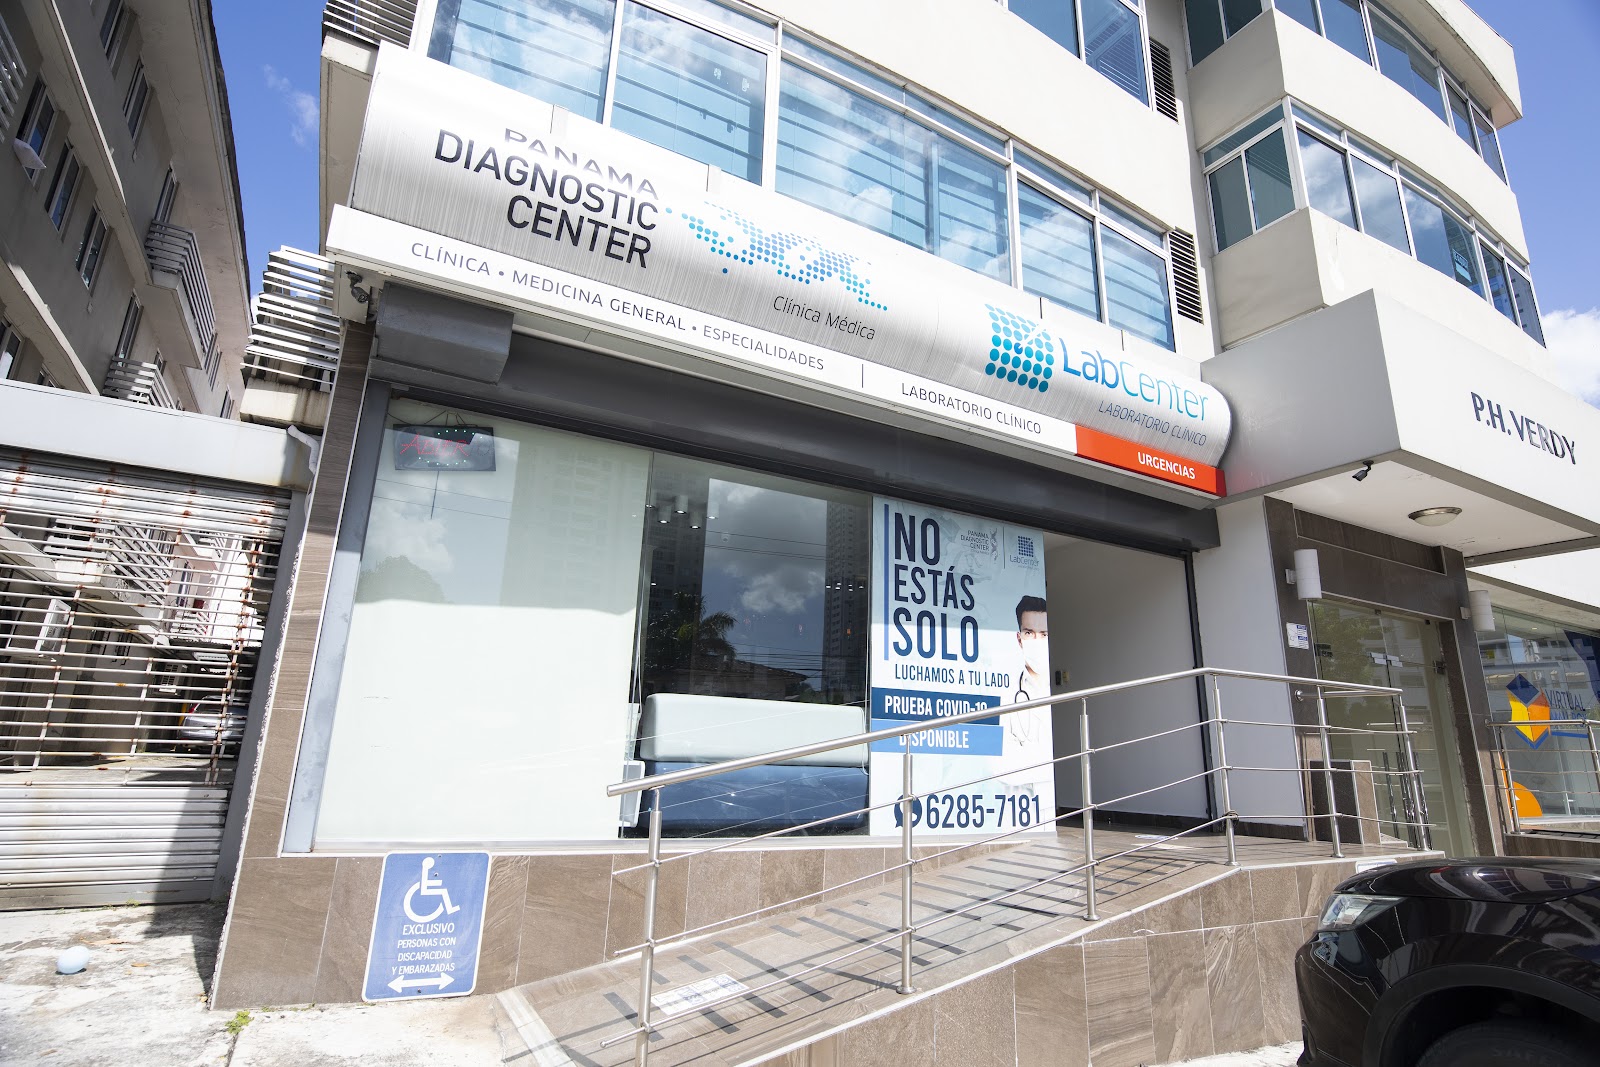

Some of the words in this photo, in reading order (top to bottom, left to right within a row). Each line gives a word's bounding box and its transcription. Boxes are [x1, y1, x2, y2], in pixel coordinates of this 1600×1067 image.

[434, 129, 659, 230] DIAGNOSTIC
[505, 128, 659, 200] PANAMA
[507, 195, 652, 268] CENTER
[411, 242, 490, 276] CLÍNICA
[512, 270, 603, 307] MEDICINA
[609, 298, 686, 331] GENERAL
[703, 324, 824, 370] ESPECIALIDADES
[773, 295, 821, 323] Clínica
[825, 312, 876, 341] Médica
[1059, 337, 1208, 421] LabCenter
[901, 383, 992, 420] LABORATORIO
[996, 411, 1042, 434] CLÍNICO
[1099, 401, 1170, 434] LABORATORIO
[1171, 425, 1207, 447] CLÍNICO
[1137, 451, 1196, 480] URGENCIAS
[894, 512, 940, 566] NO
[960, 534, 990, 546] DIAGNOSTIC
[967, 529, 989, 540] PANAMA
[970, 542, 990, 551] CENTER
[1009, 555, 1040, 567] LabCenter
[894, 563, 976, 611] ESTÁS
[893, 607, 979, 663] SOLO
[895, 663, 955, 683] LUCHAMOS
[958, 669, 965, 685] A
[969, 670, 981, 686] TU
[984, 672, 1010, 688] LADO
[885, 695, 932, 716] PRUEBA
[1545, 689, 1586, 711] VIRTUAL
[926, 794, 1040, 828] 6285-7181
[397, 938, 437, 948] PERSONAS
[439, 936, 457, 946] CON
[402, 922, 455, 935] EXCLUSIVO
[391, 966, 398, 975] Y
[398, 962, 455, 975] EMBARAZADAS
[397, 950, 452, 961] DISCAPACIDAD
